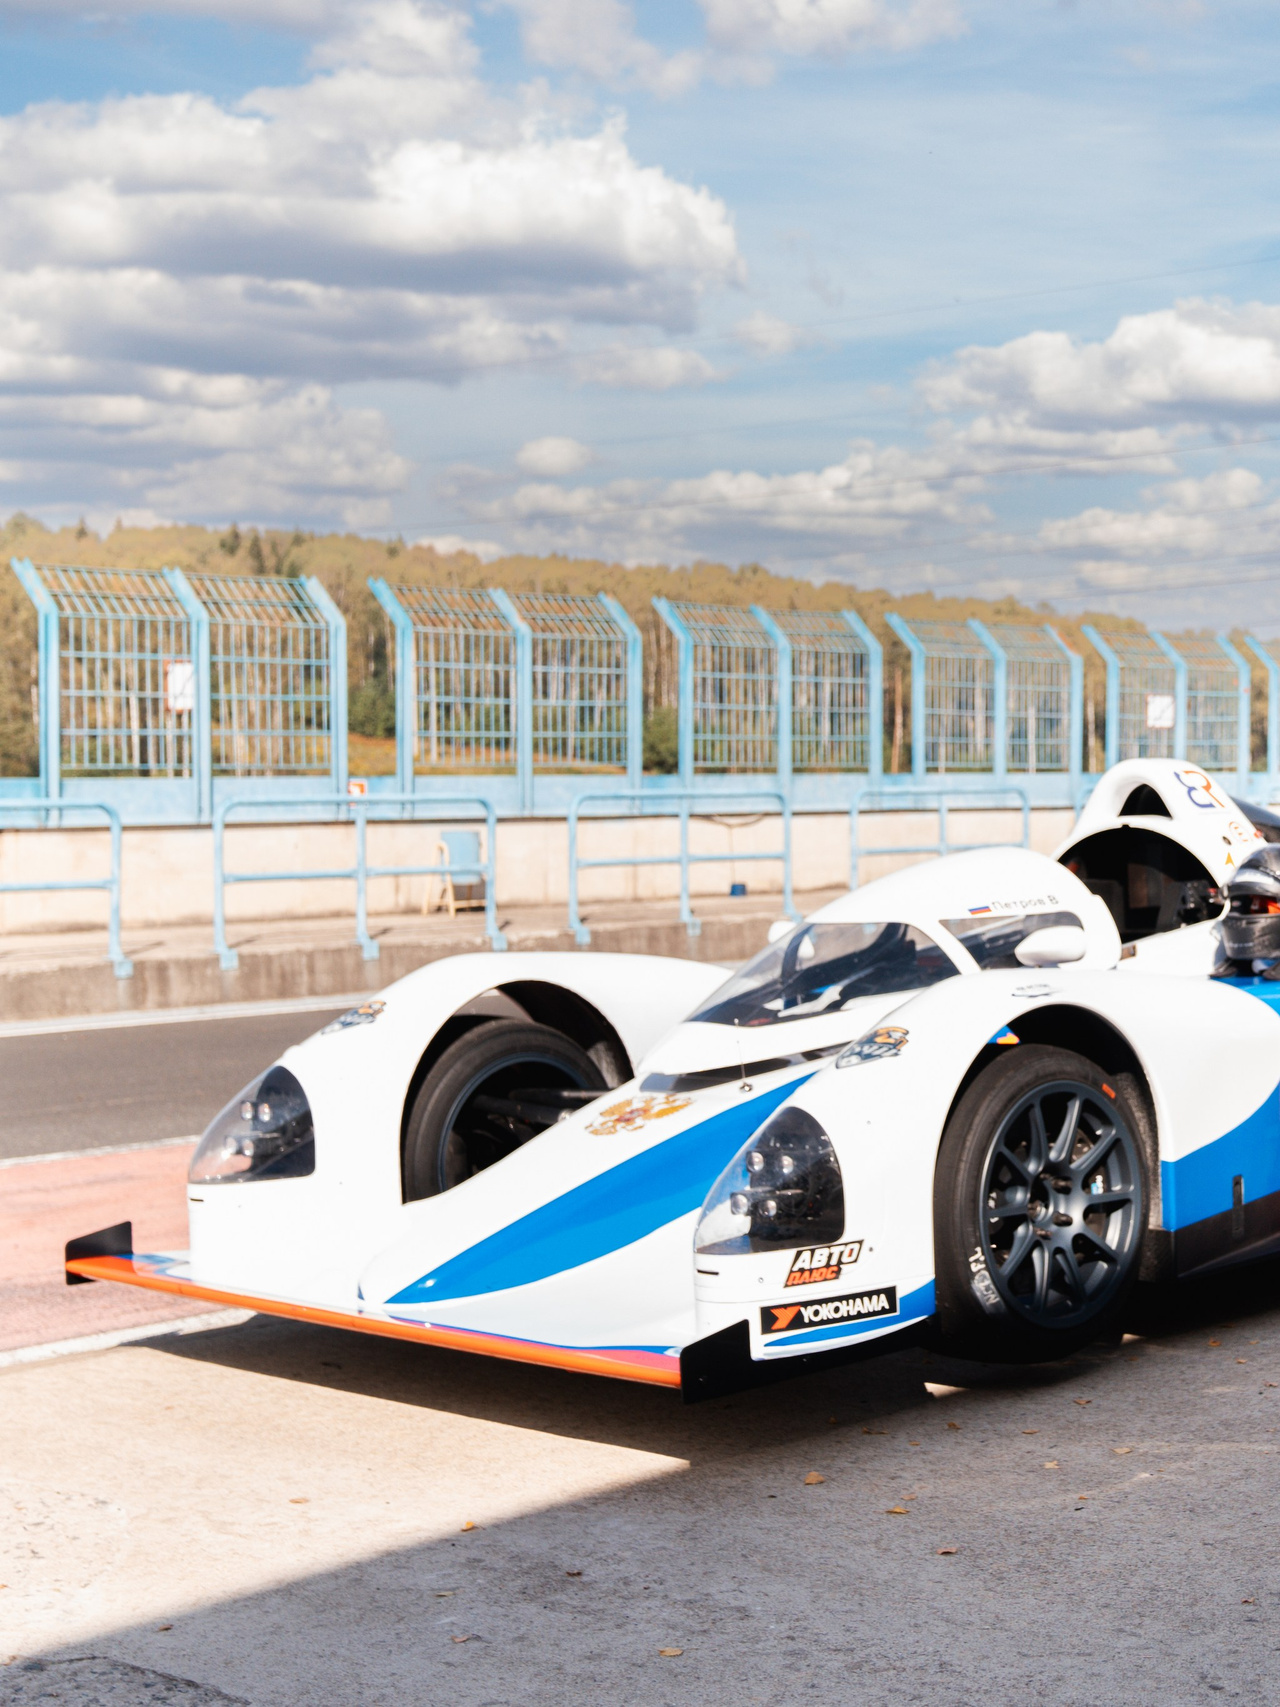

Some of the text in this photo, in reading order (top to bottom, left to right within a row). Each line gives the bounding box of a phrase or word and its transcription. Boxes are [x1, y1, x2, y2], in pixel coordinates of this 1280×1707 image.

[991, 898, 1046, 911] Петров
[791, 1242, 861, 1271] АВТО
[786, 1265, 839, 1286] ПЛЮС
[800, 1293, 890, 1323] YOKOHAMA
